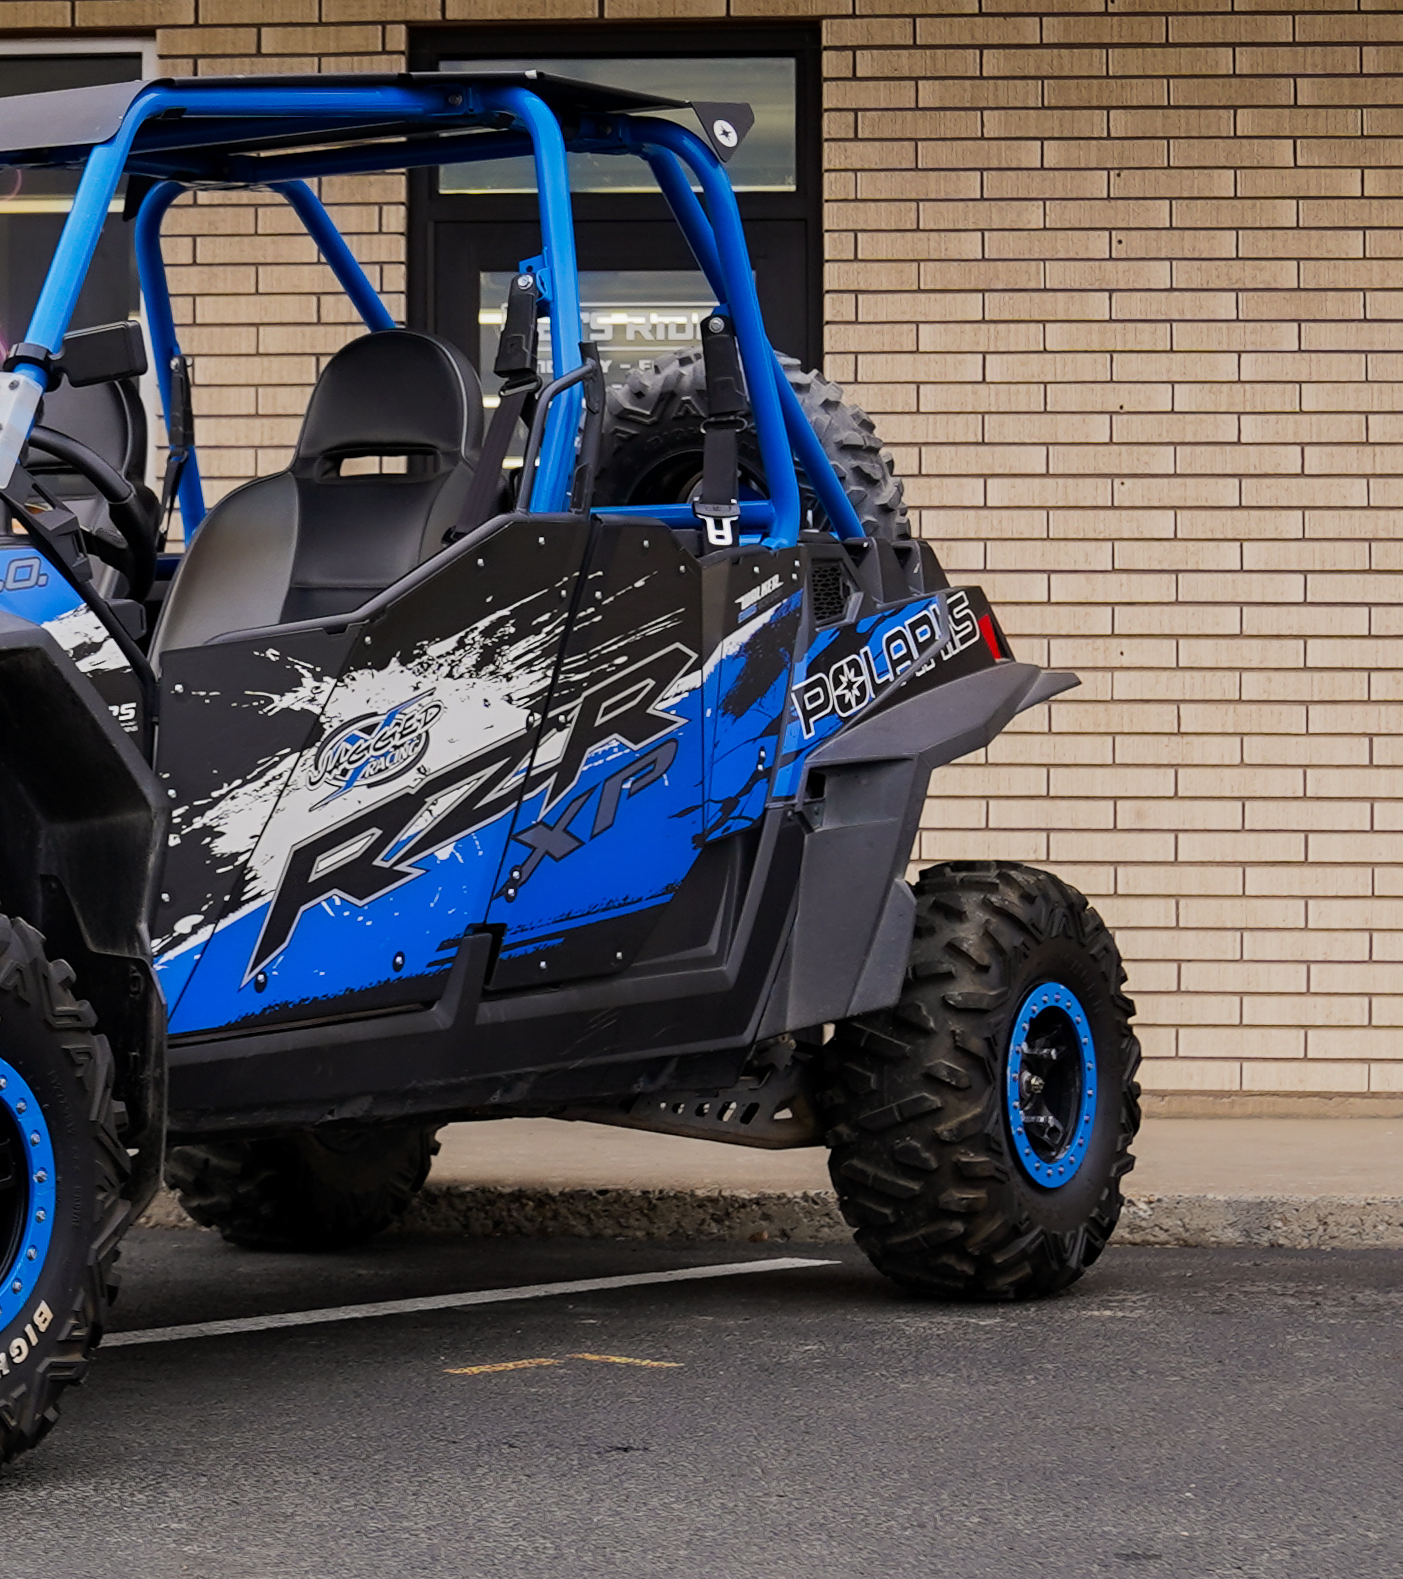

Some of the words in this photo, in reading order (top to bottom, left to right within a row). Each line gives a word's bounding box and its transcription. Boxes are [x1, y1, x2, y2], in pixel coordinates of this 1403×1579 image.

[790, 590, 980, 741] POLARIS
[238, 642, 698, 993] RZR
[363, 738, 421, 779] RACING
[493, 738, 679, 901] XP
